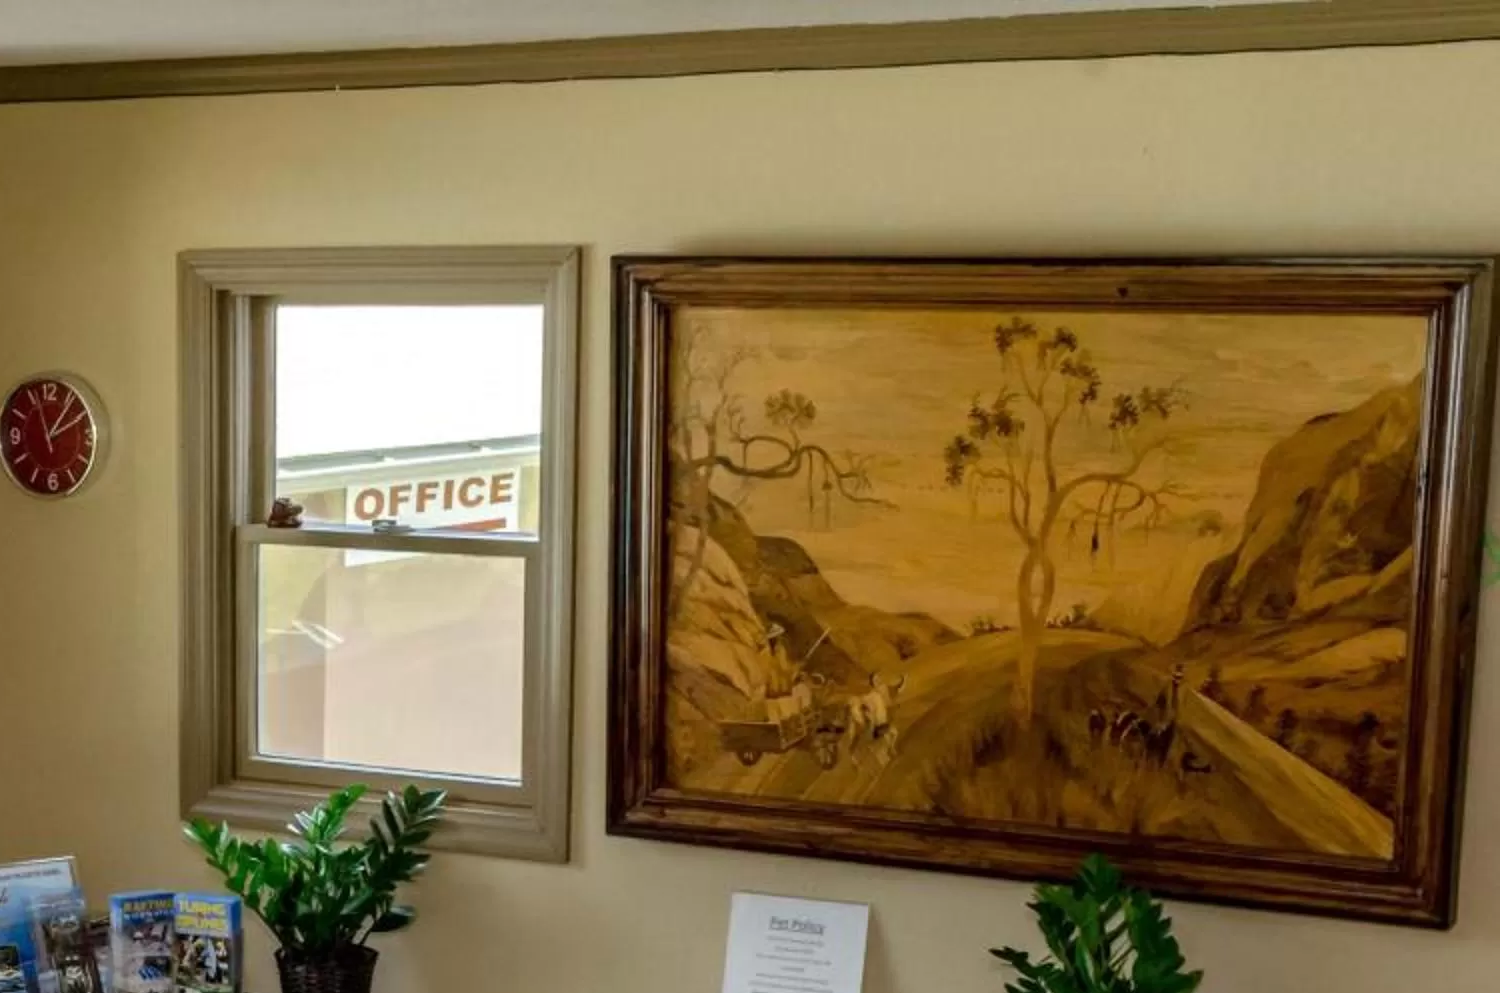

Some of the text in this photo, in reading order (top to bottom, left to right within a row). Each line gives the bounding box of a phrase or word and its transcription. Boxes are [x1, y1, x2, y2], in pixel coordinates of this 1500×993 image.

[42, 383, 58, 401] 12
[9, 427, 21, 445] 9
[47, 472, 60, 491] 6
[353, 472, 515, 521] OFFICE
[769, 915, 826, 936] Pet Policy
